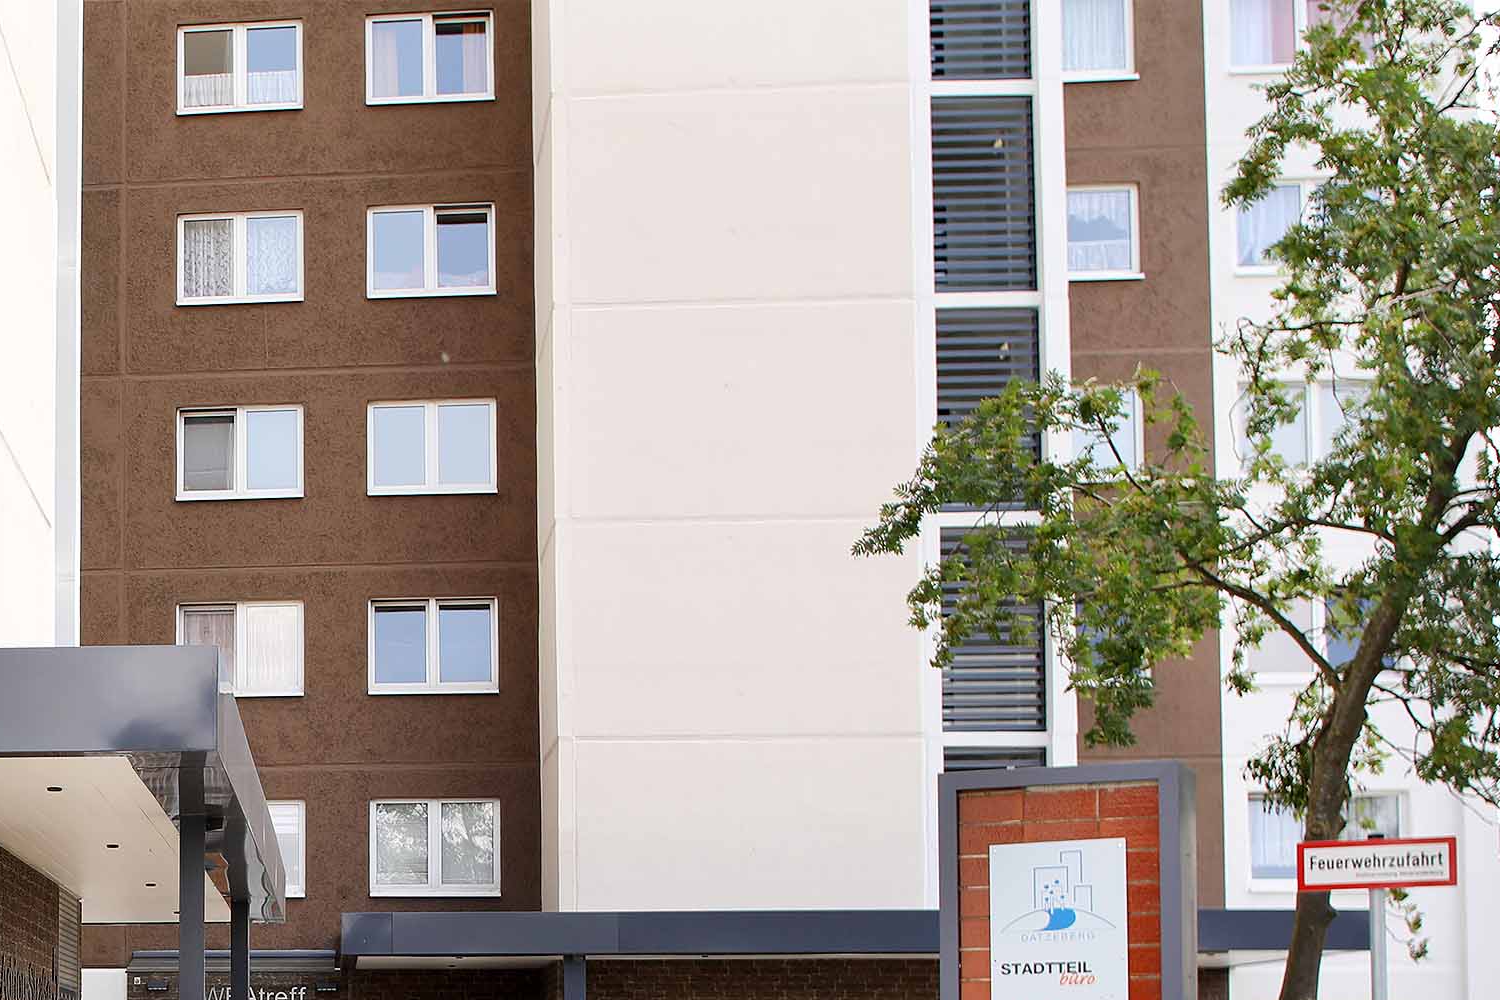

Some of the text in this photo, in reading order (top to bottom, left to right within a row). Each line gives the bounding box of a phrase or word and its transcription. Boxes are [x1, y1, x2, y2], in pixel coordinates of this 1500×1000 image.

[1309, 851, 1444, 871] Feuerwehrzufahrt
[1000, 961, 1092, 975] STADTTEIL
[1059, 971, 1096, 986] büro
